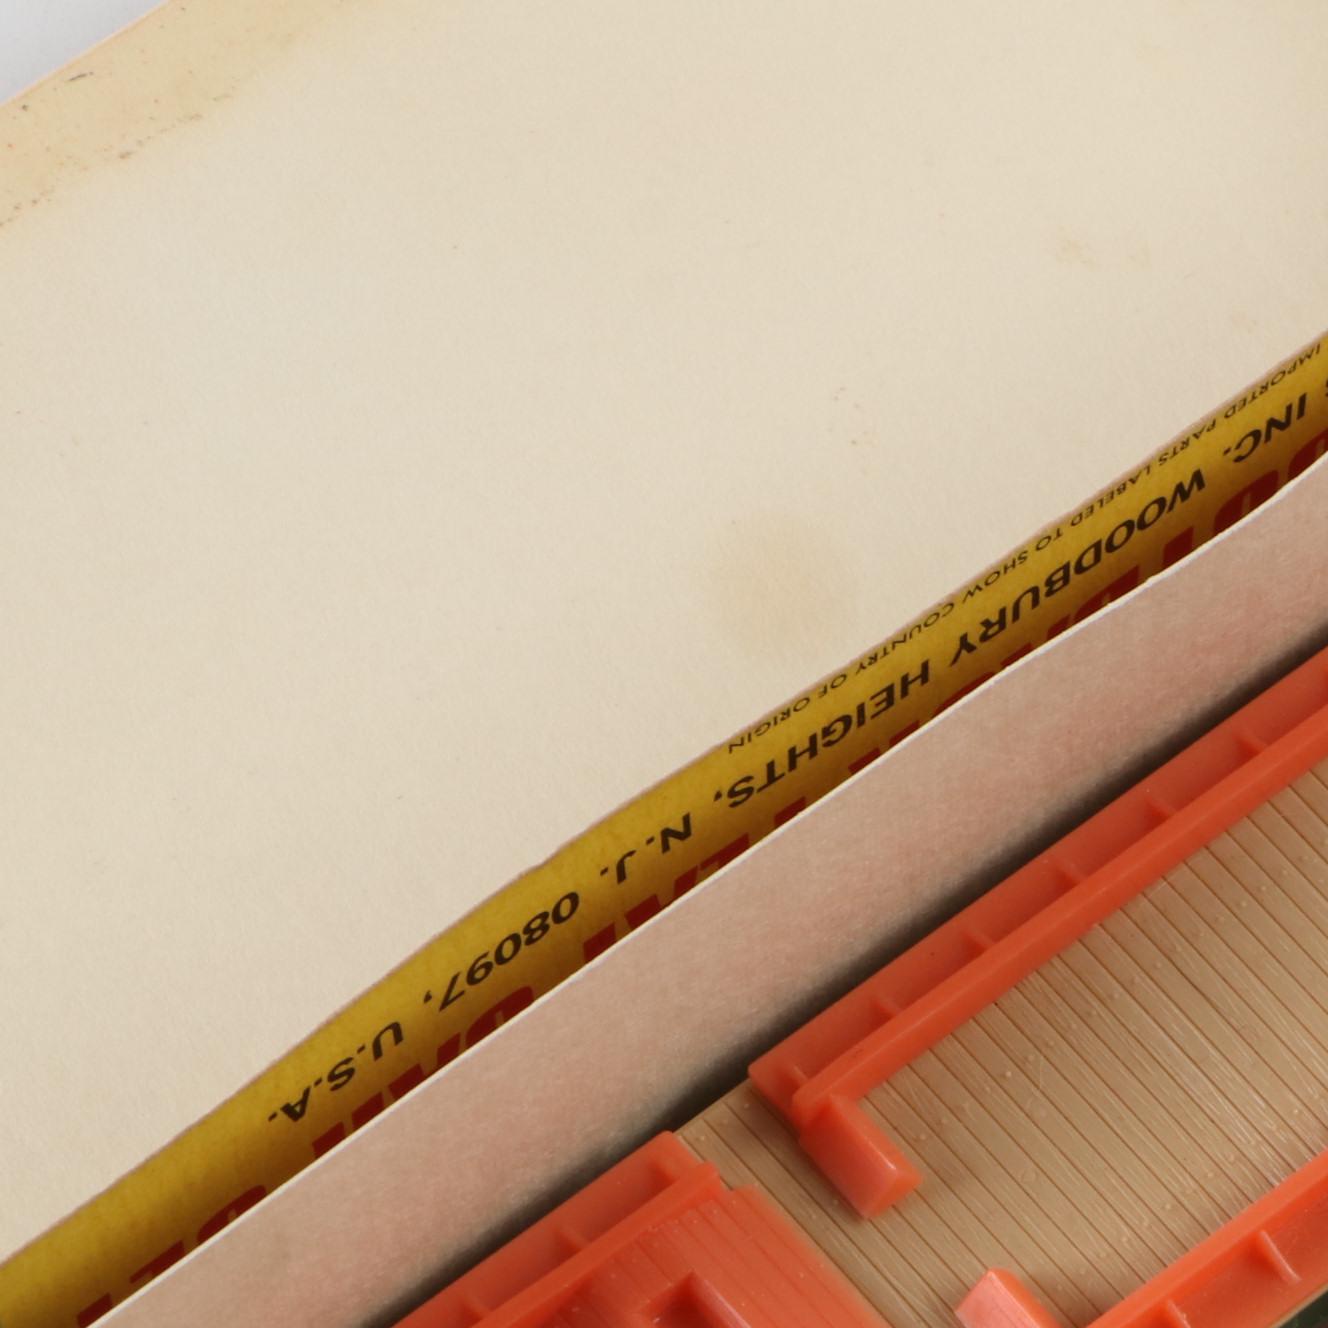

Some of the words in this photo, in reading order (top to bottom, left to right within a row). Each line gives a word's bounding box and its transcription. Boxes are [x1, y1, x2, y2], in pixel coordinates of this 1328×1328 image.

[1224, 342, 1321, 420] IMPORTED
[1157, 416, 1217, 467] PARTS
[1223, 392, 1307, 463] INC.
[1069, 465, 1152, 527] LABELED
[950, 468, 1206, 667] WOODBURY
[1034, 526, 1064, 552] TO
[961, 549, 1029, 604] SHOW
[854, 602, 955, 676] COUNTRY
[816, 673, 848, 700] OF
[713, 659, 931, 808] HEIGHTS,
[727, 696, 812, 755] ORIGIN
[423, 891, 581, 1012] 08097,
[267, 1021, 405, 1124] U.S.A.
